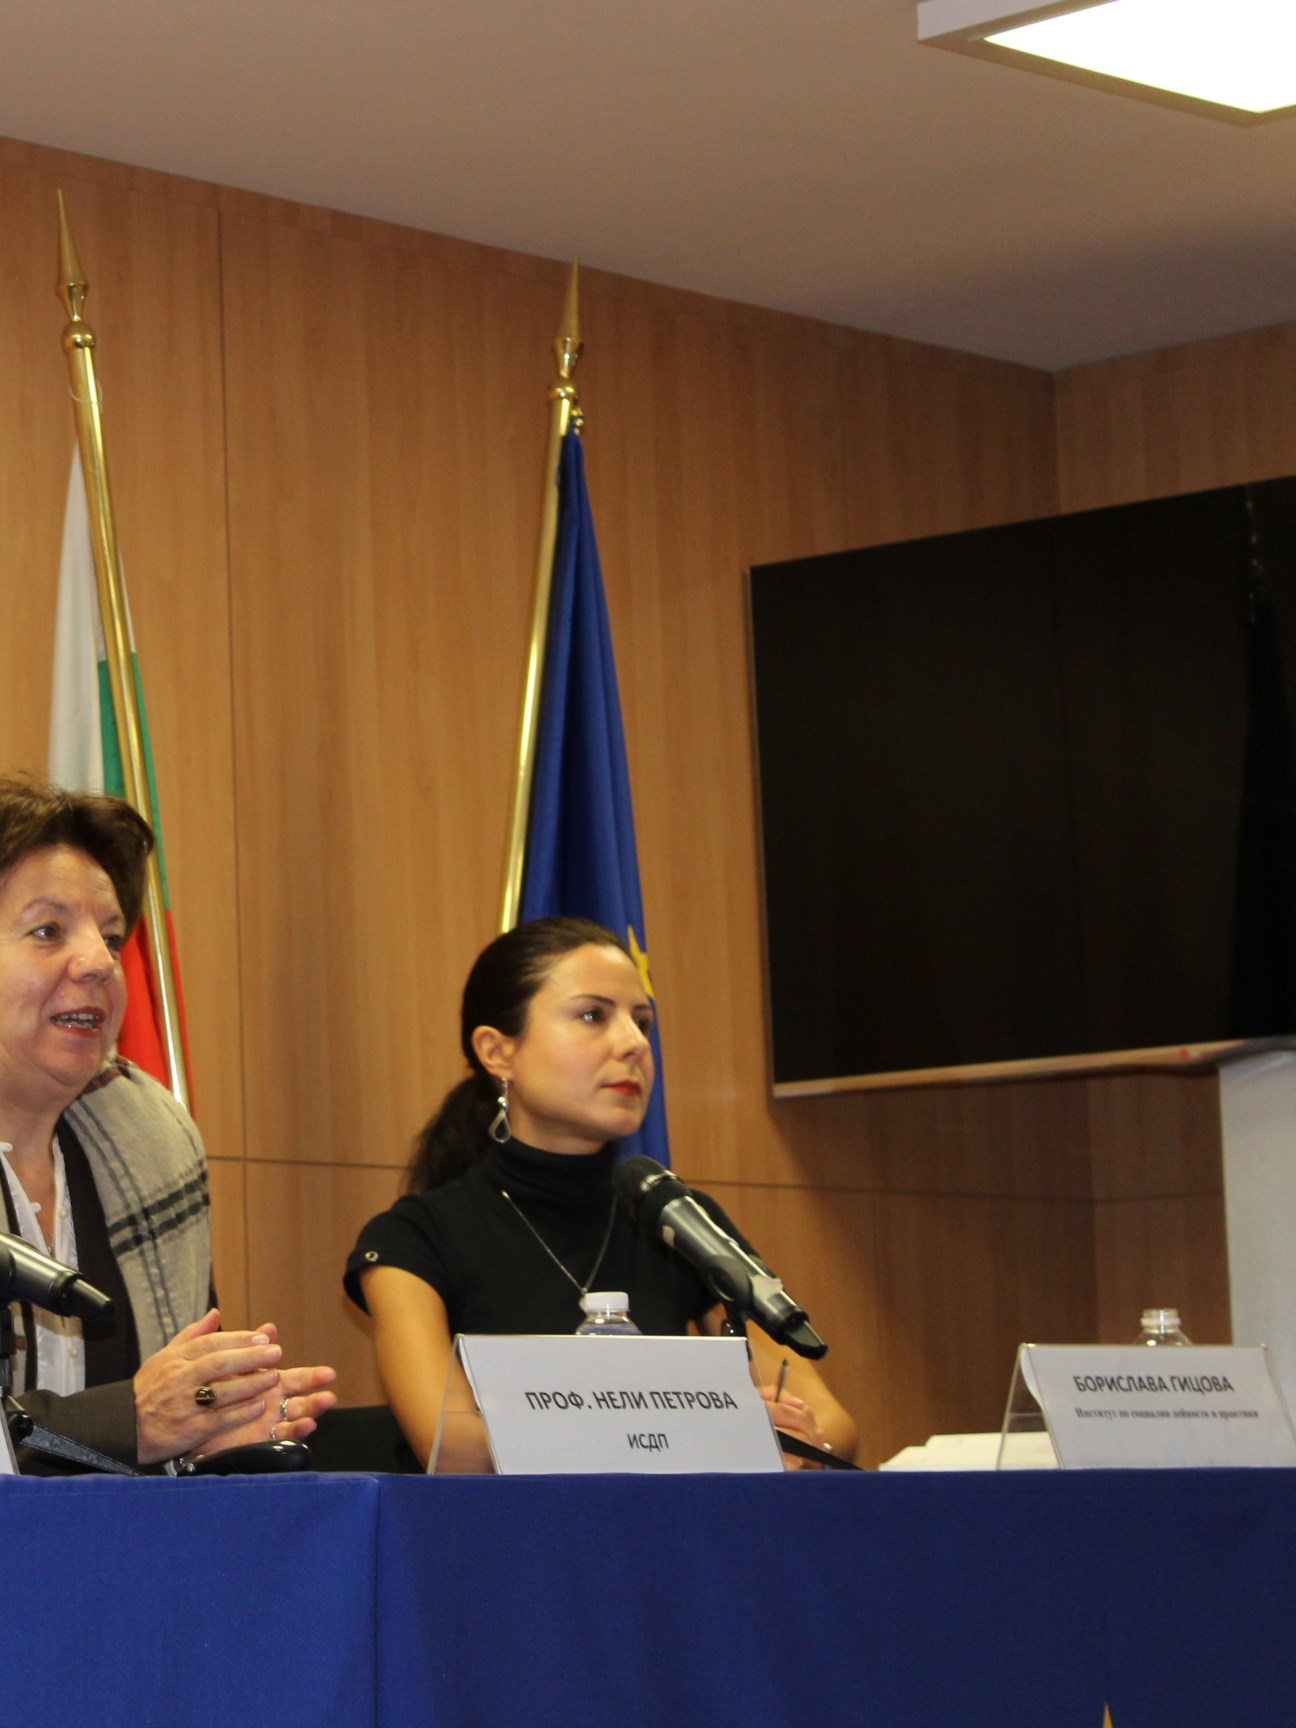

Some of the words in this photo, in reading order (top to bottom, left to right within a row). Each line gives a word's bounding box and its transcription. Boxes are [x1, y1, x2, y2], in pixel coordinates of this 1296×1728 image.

[1073, 1376, 1170, 1393] БОРИСЛАВА
[1169, 1376, 1234, 1395] ГИЦОВА
[525, 1391, 592, 1410] ПРОФ.
[592, 1391, 649, 1410] НЕЛИ
[649, 1391, 738, 1409] ПЕТРОВА
[627, 1433, 669, 1452] ИСДП
